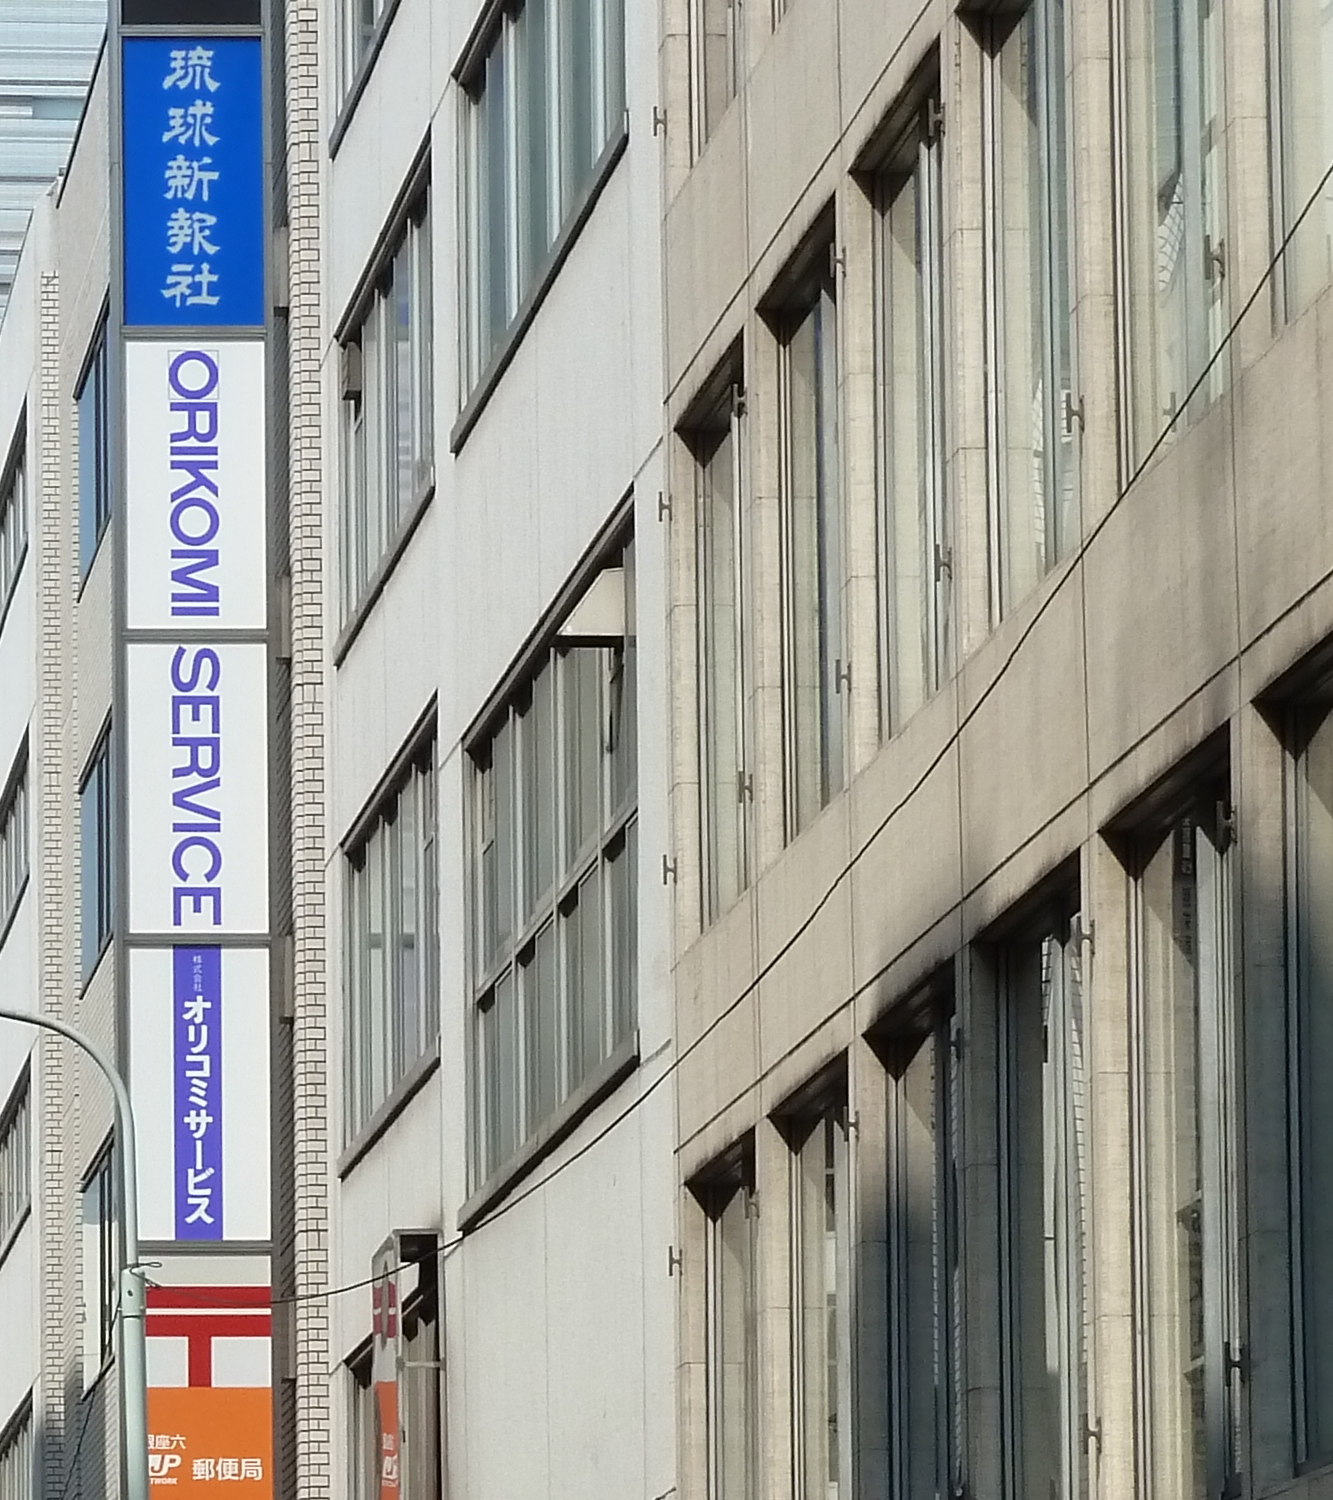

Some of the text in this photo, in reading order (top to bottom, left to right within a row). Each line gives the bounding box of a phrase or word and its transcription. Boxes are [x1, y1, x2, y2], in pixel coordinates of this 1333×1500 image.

[161, 46, 221, 308] 琉球新報社
[168, 350, 220, 617] ORIKOMI
[170, 646, 222, 926] SERVICE
[183, 995, 215, 1225] オリコミサービス
[192, 1458, 263, 1481] 郵便局
